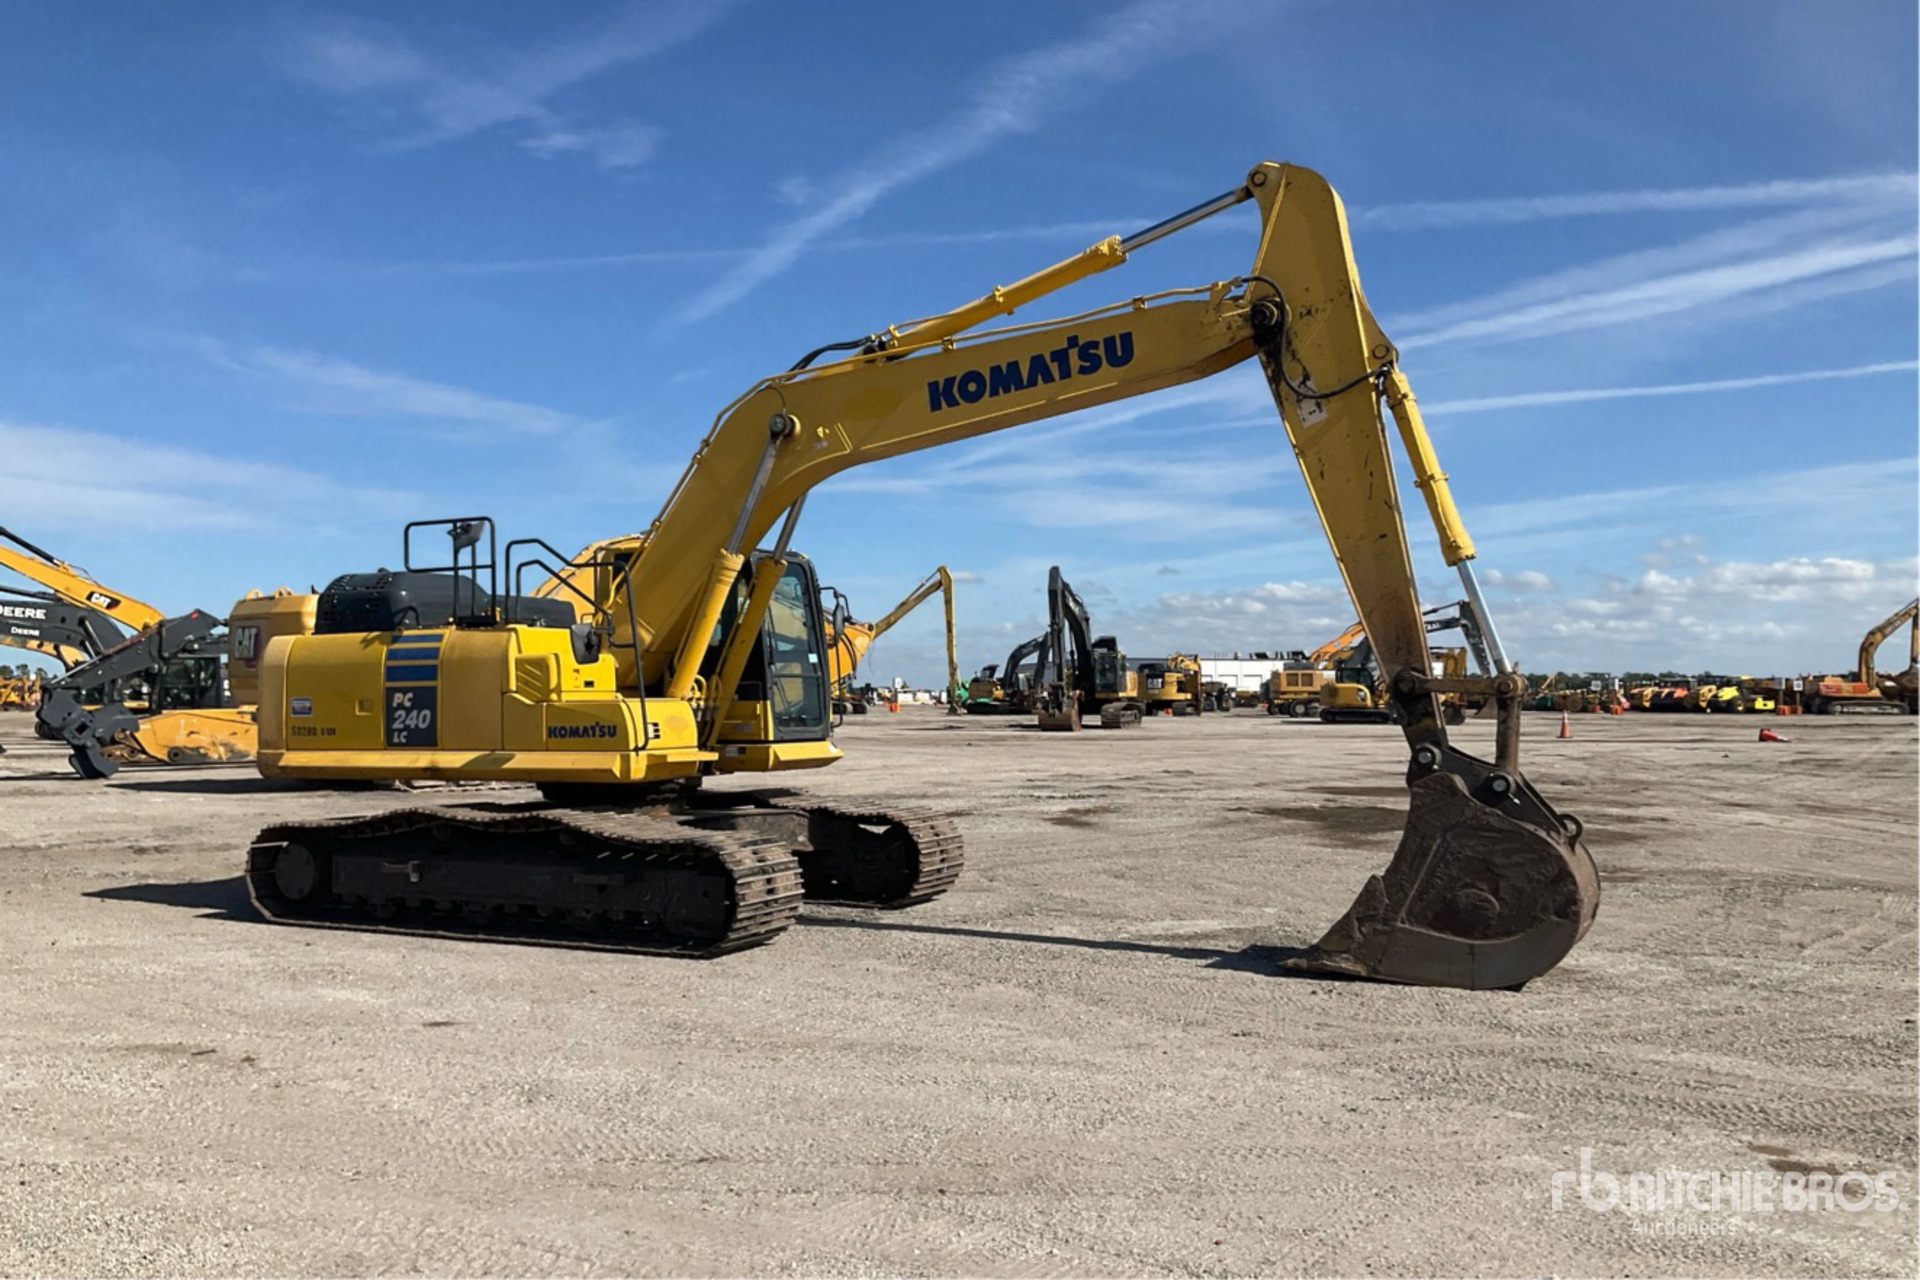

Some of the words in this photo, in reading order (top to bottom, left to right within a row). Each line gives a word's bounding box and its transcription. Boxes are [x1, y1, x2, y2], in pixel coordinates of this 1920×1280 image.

[927, 331, 1135, 413] KOMATSU
[91, 592, 112, 608] CAT
[11, 626, 40, 636] DEERE
[234, 627, 258, 659] CAT
[1147, 678, 1163, 689] CAT
[392, 692, 413, 707] PC
[392, 709, 431, 729] 240
[393, 731, 408, 743] LC
[547, 721, 618, 739] KOMATSU
